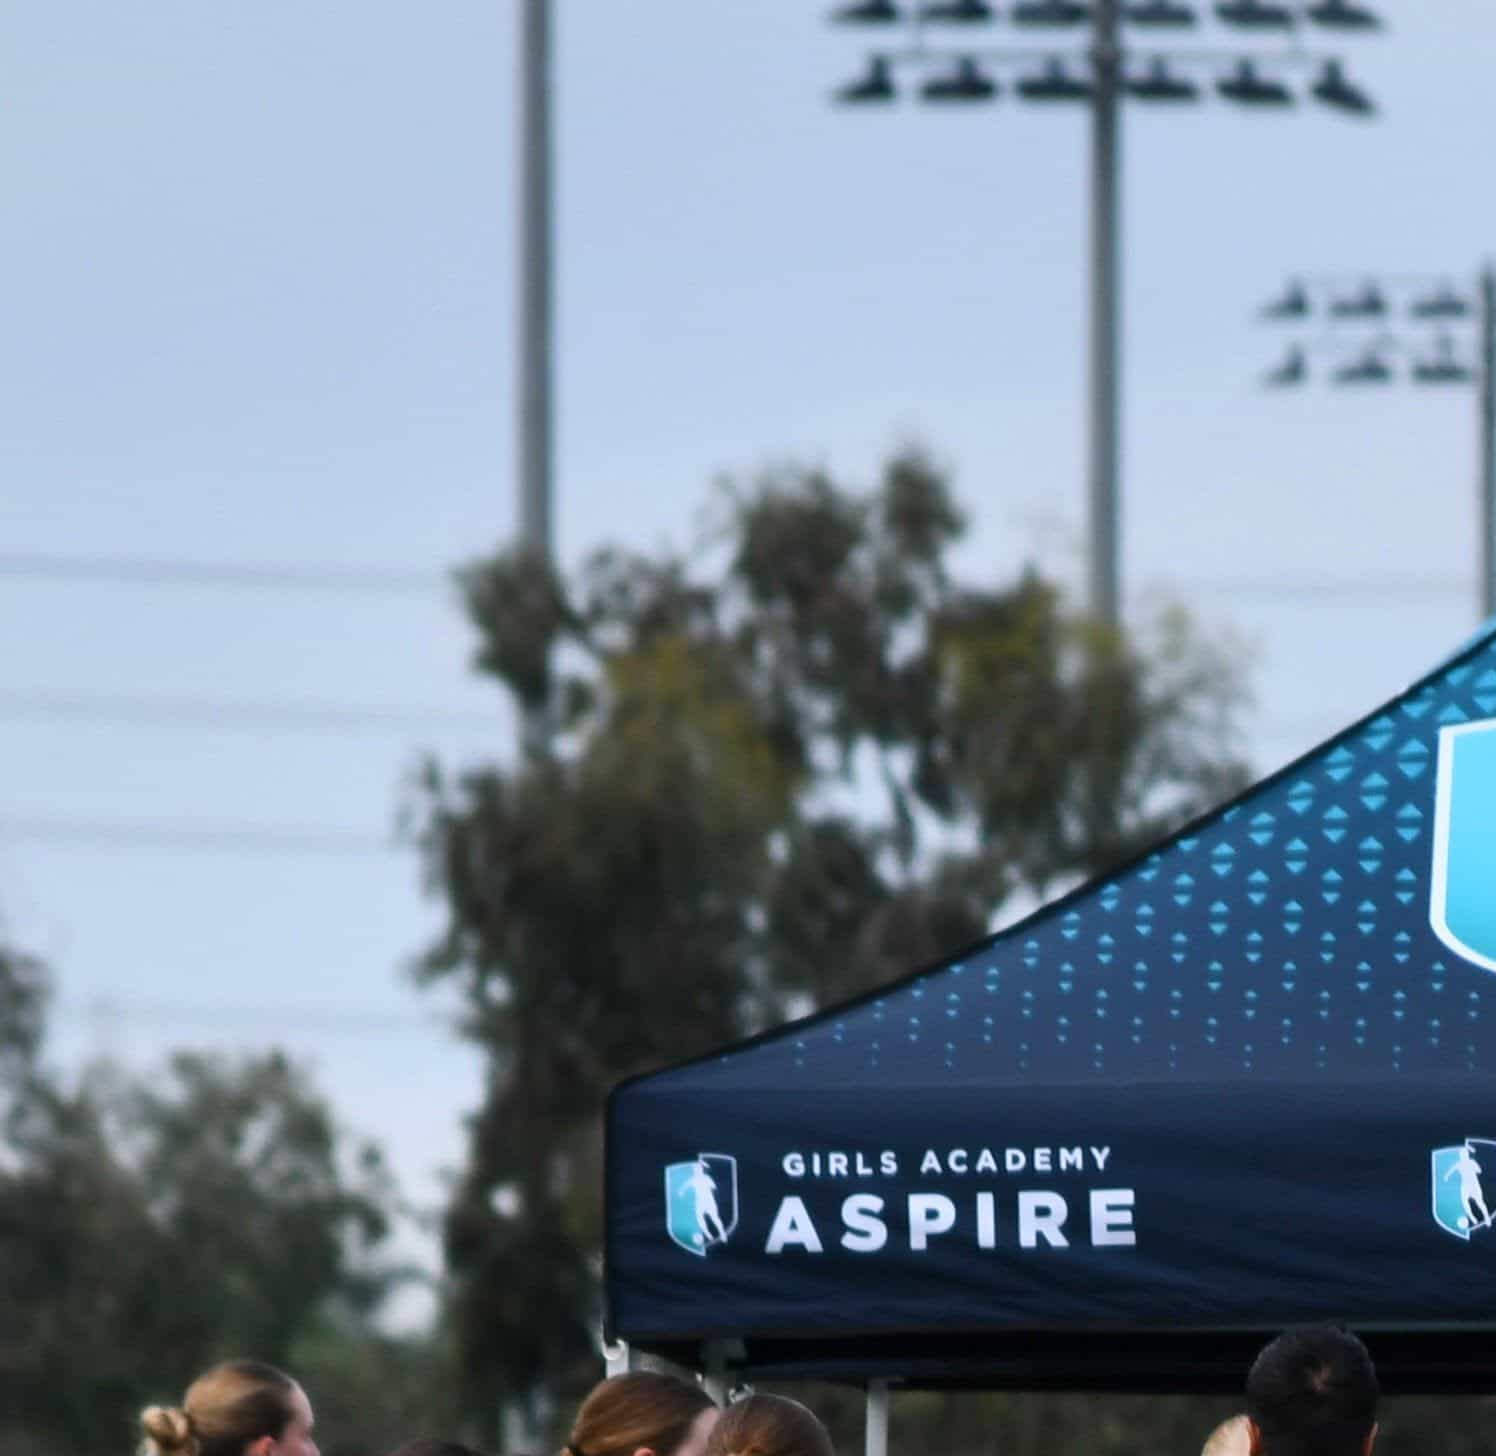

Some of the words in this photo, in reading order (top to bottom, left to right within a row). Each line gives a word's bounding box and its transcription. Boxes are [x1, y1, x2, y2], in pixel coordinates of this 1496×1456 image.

[782, 1150, 898, 1177] GIRLS
[920, 1146, 1111, 1174] ACADEMY
[765, 1188, 1137, 1253] ASPIRE
